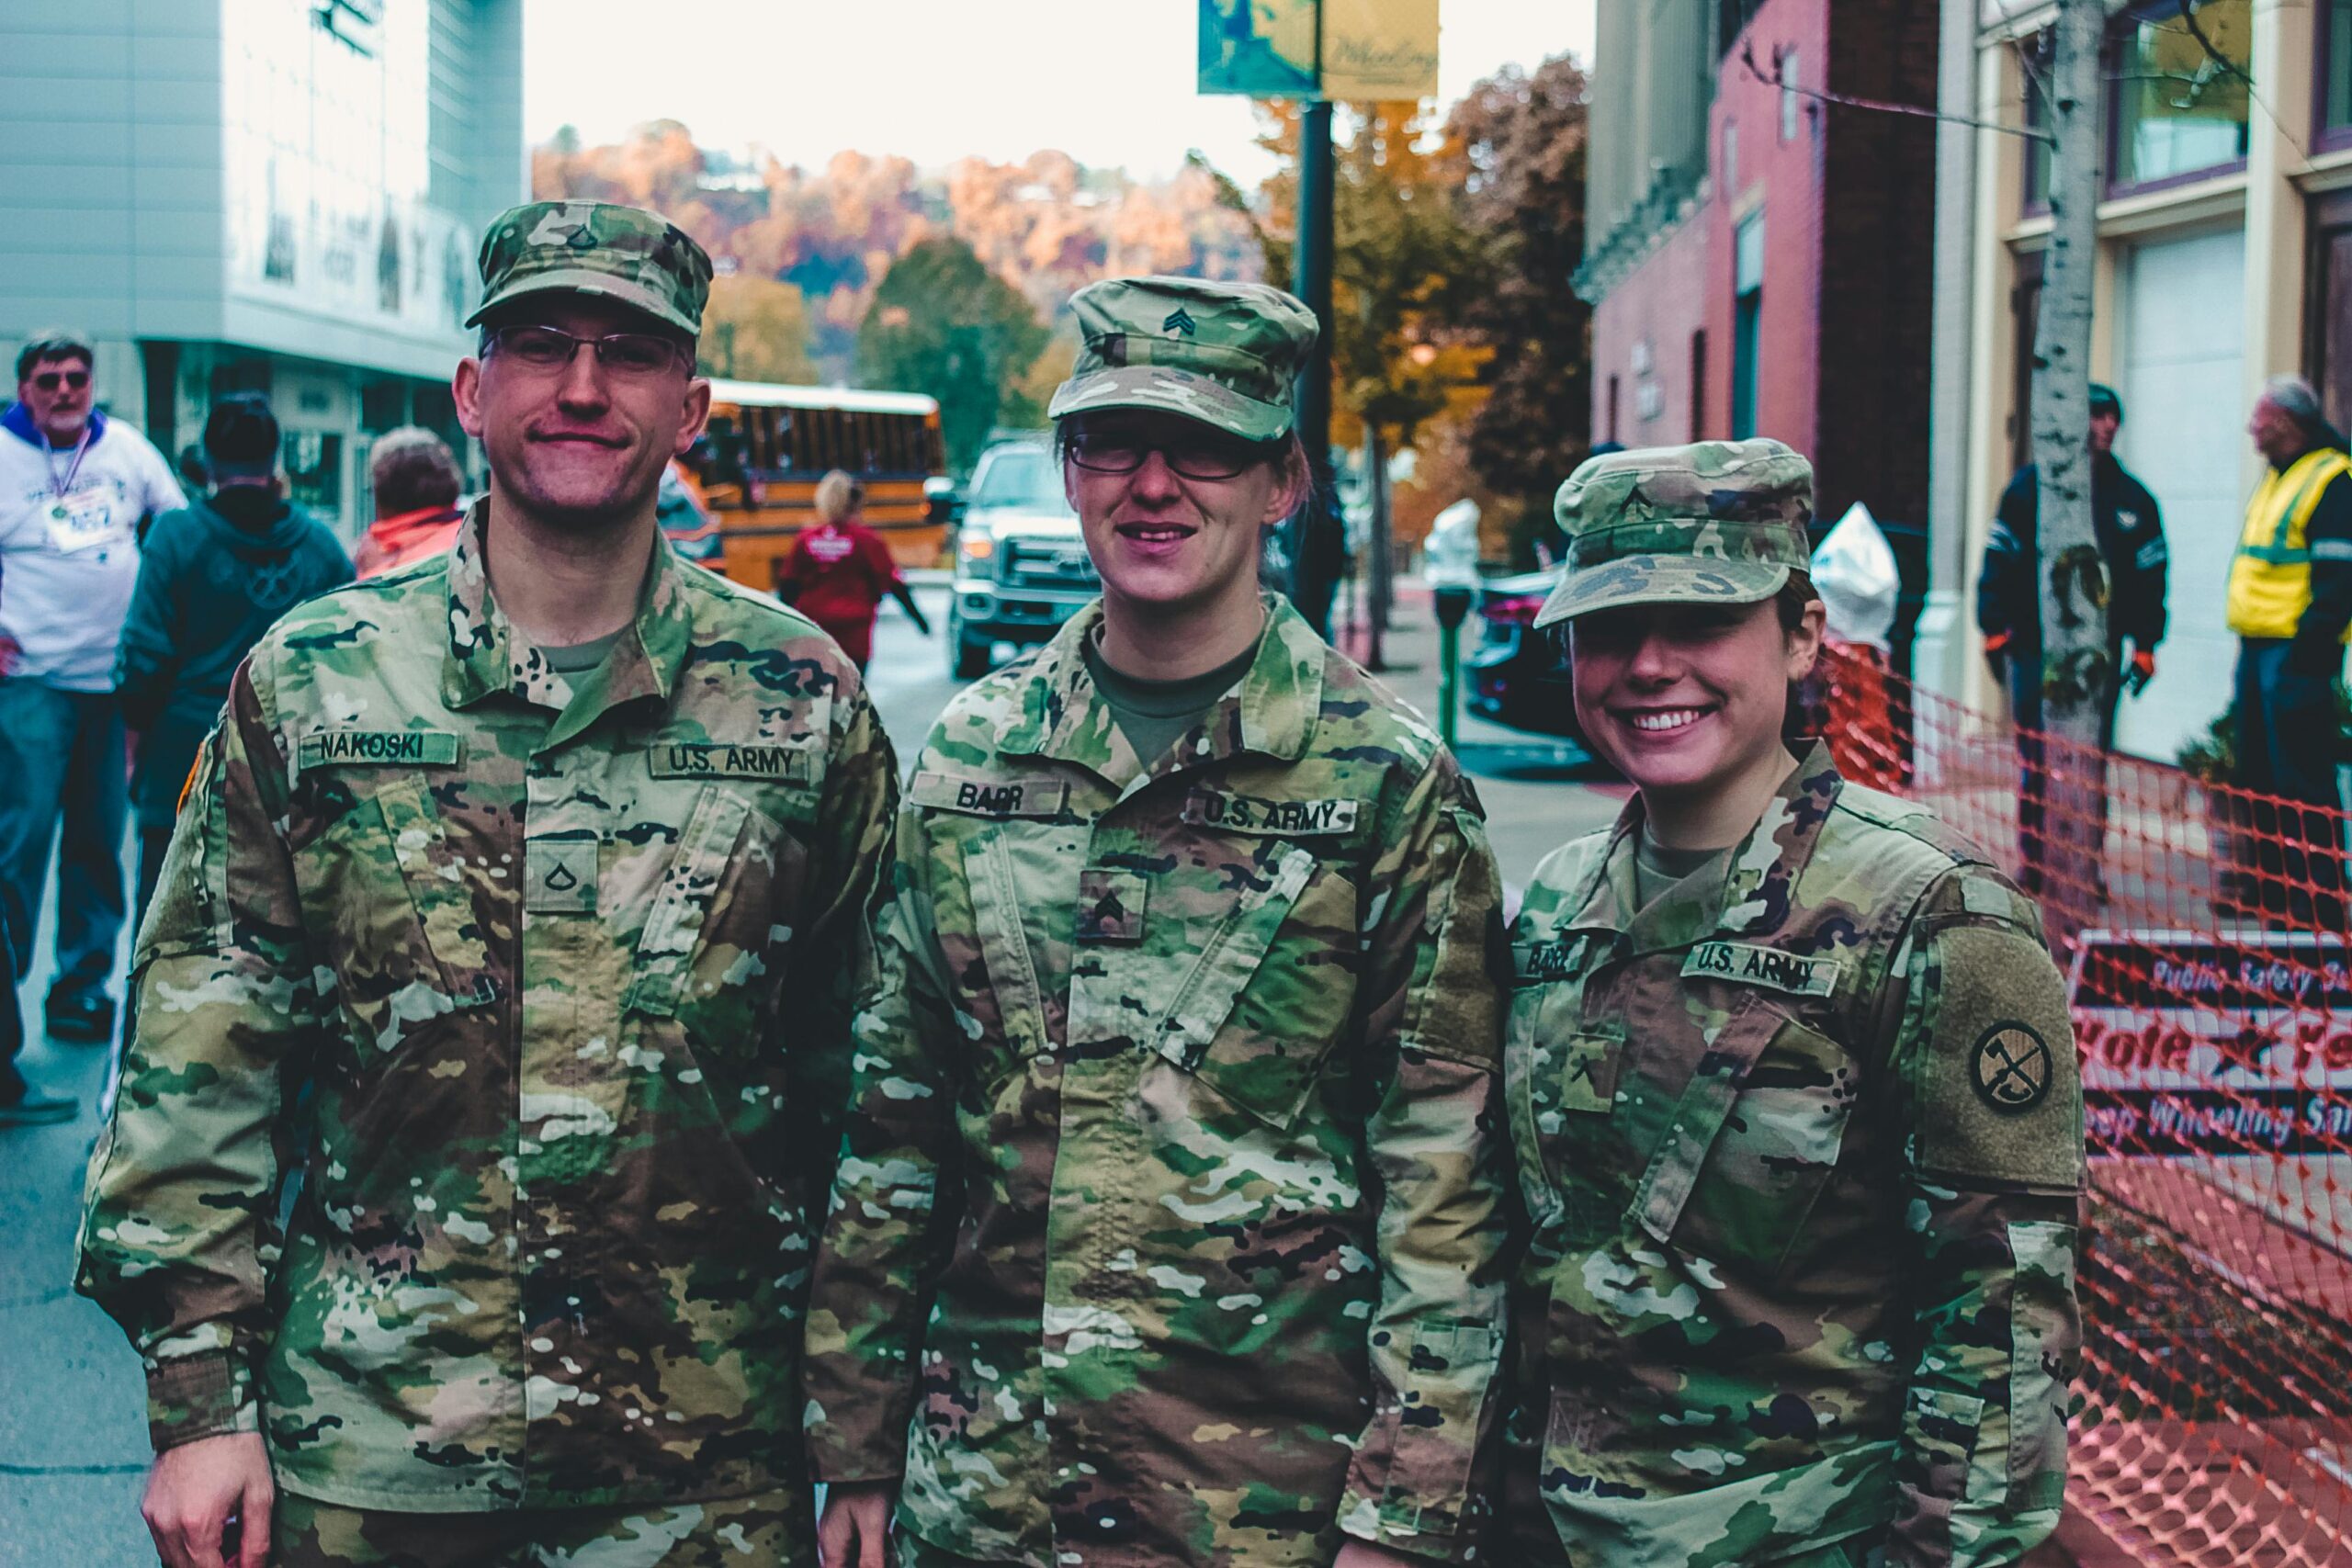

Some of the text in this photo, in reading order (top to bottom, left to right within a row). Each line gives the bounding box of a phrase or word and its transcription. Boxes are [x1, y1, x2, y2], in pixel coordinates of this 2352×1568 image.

[320, 733, 424, 760] NAKOSKI
[669, 744, 795, 775] U.S. ARMY
[956, 782, 1024, 812] BARR
[1204, 798, 1337, 832] U.S. ARMY
[1698, 944, 1815, 989] U.S. ARMY
